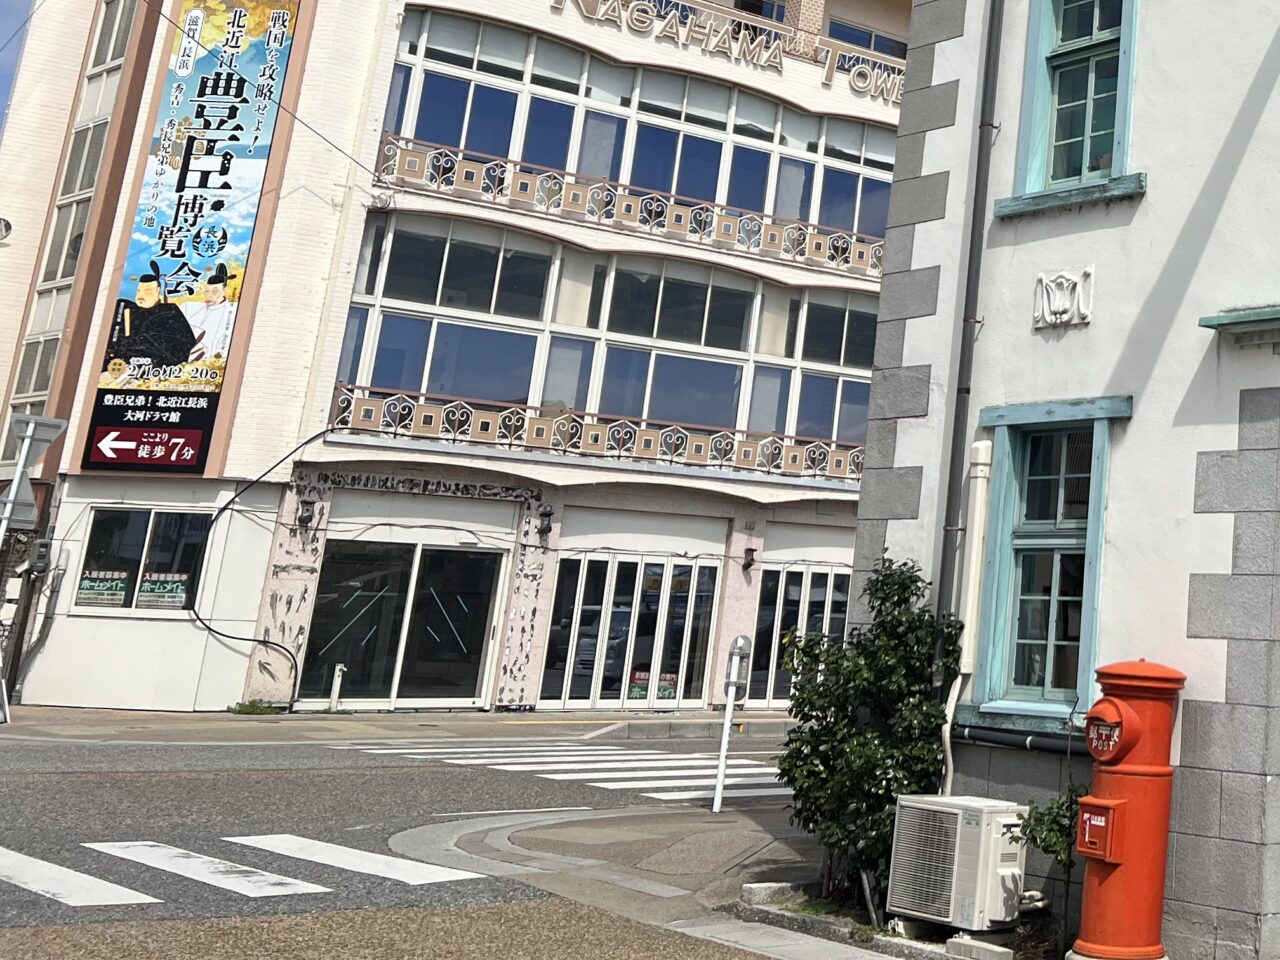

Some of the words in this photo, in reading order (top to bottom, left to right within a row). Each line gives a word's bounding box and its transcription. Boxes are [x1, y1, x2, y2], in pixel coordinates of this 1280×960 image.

[123, 409, 181, 423] 大河ドラマ館
[141, 432, 169, 443] ここより
[1092, 739, 1115, 751] POST
